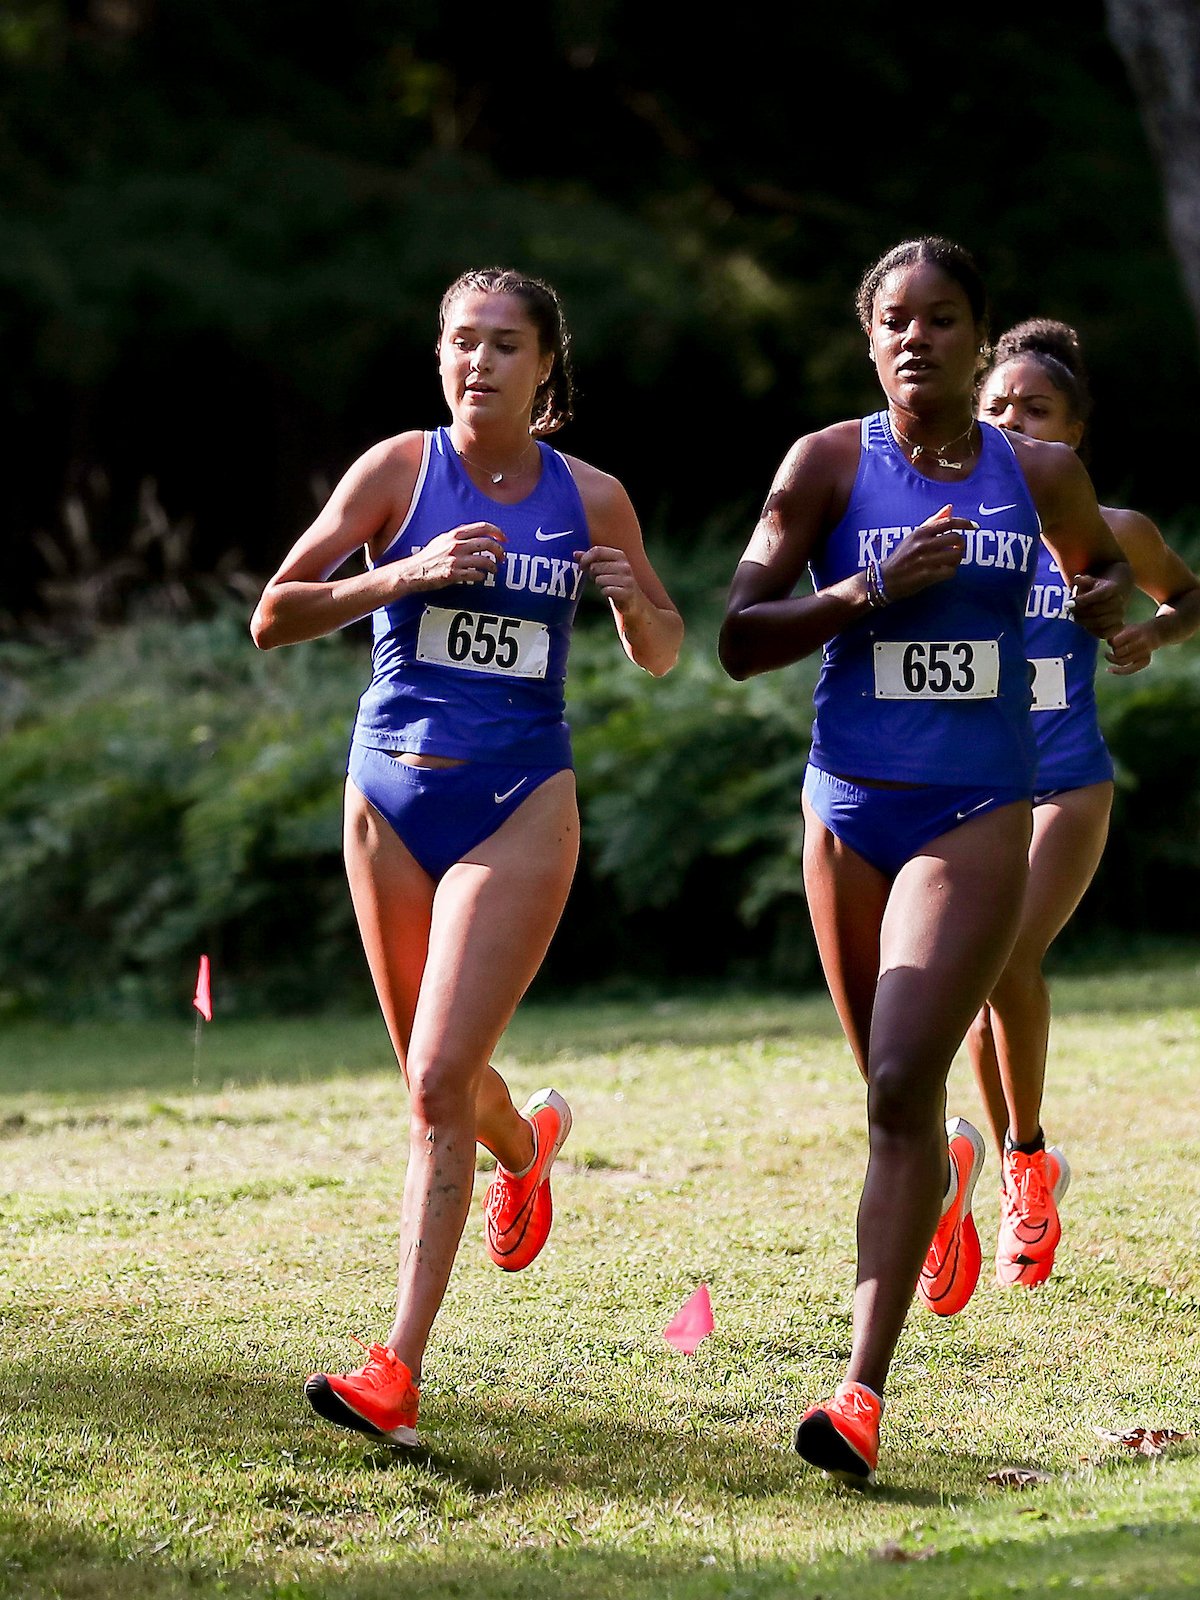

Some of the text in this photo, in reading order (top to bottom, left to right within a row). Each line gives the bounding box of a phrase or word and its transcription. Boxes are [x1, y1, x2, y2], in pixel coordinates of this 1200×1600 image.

[411, 546, 584, 600] TUCKY
[858, 526, 1033, 573] KEUCKY
[448, 611, 521, 668] 655
[903, 643, 975, 692] 653
